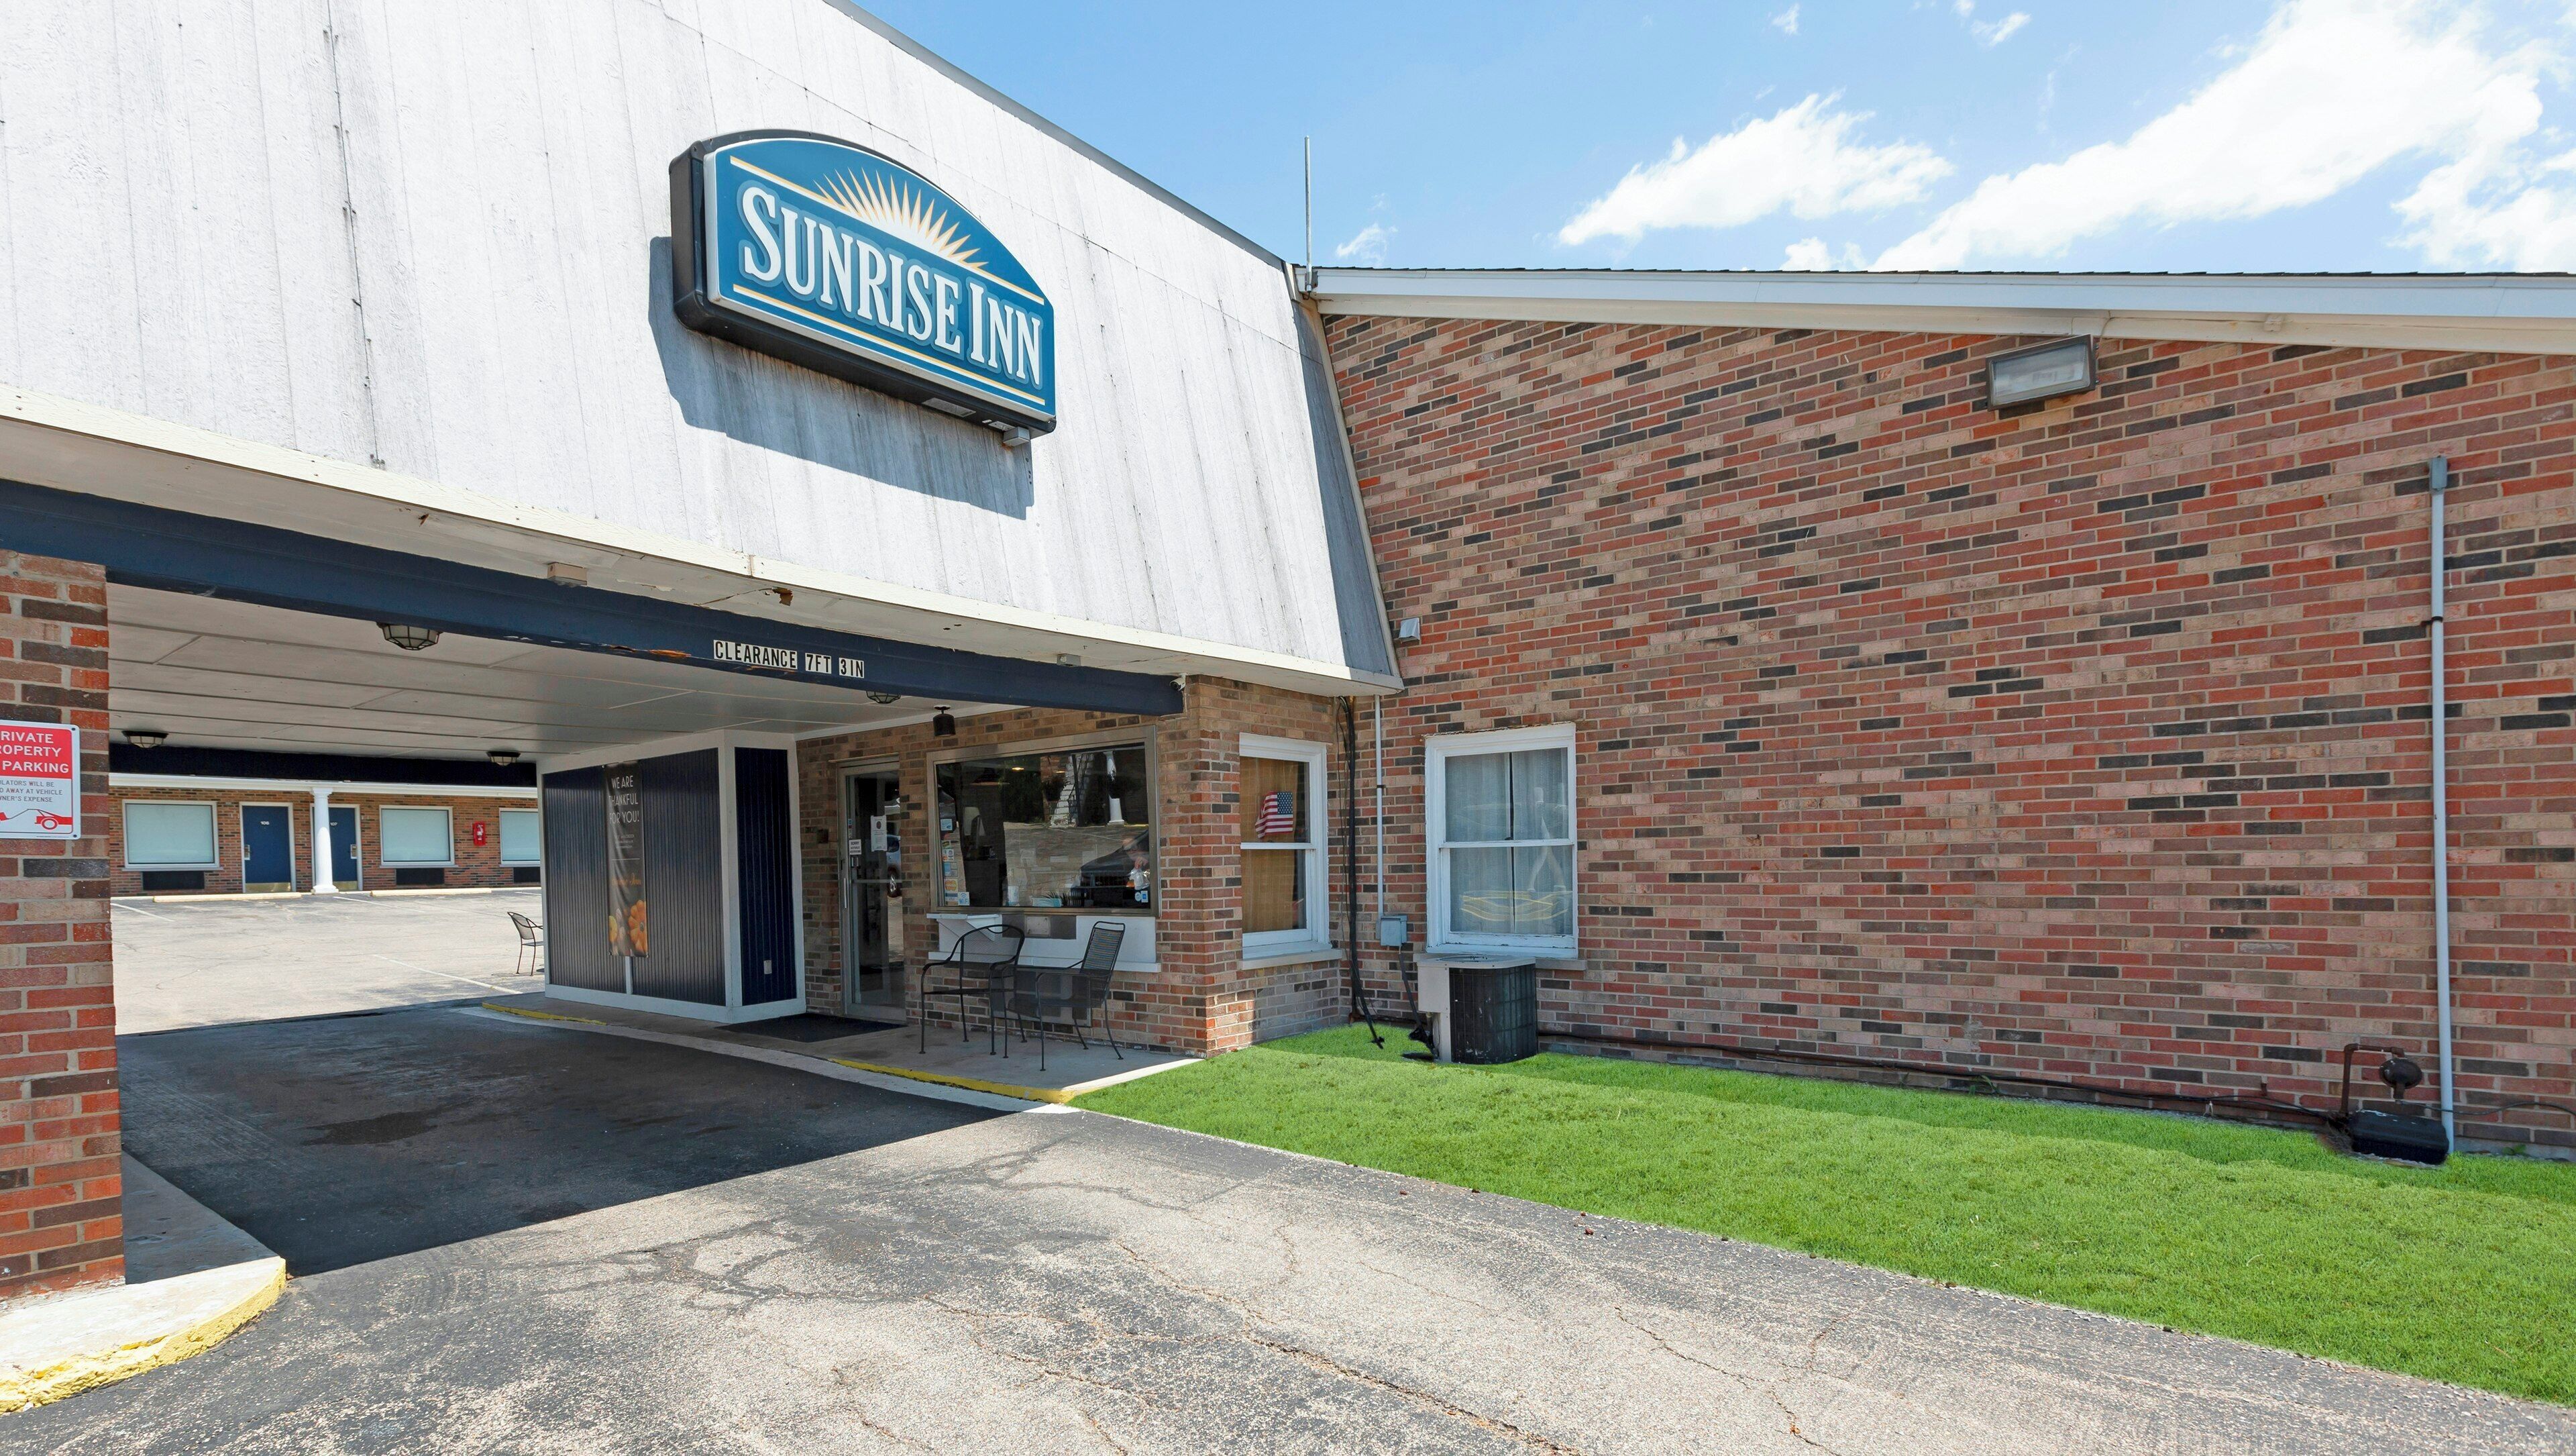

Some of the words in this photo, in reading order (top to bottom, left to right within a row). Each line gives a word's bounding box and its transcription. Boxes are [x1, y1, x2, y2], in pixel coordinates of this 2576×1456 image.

[742, 187, 962, 354] SUNRISE
[969, 282, 1040, 386] INN
[714, 640, 797, 669] CLEARANCE
[806, 654, 831, 673] 7FT
[840, 658, 864, 678] 3IN
[0, 731, 54, 743] RIVATE
[0, 744, 62, 757] OPERTY
[2, 760, 69, 774] PARKING
[611, 777, 620, 789] WE
[621, 775, 633, 788] ARE
[608, 792, 639, 807] THANKFUL
[609, 812, 621, 824] FOR
[622, 810, 640, 823] YOU!
